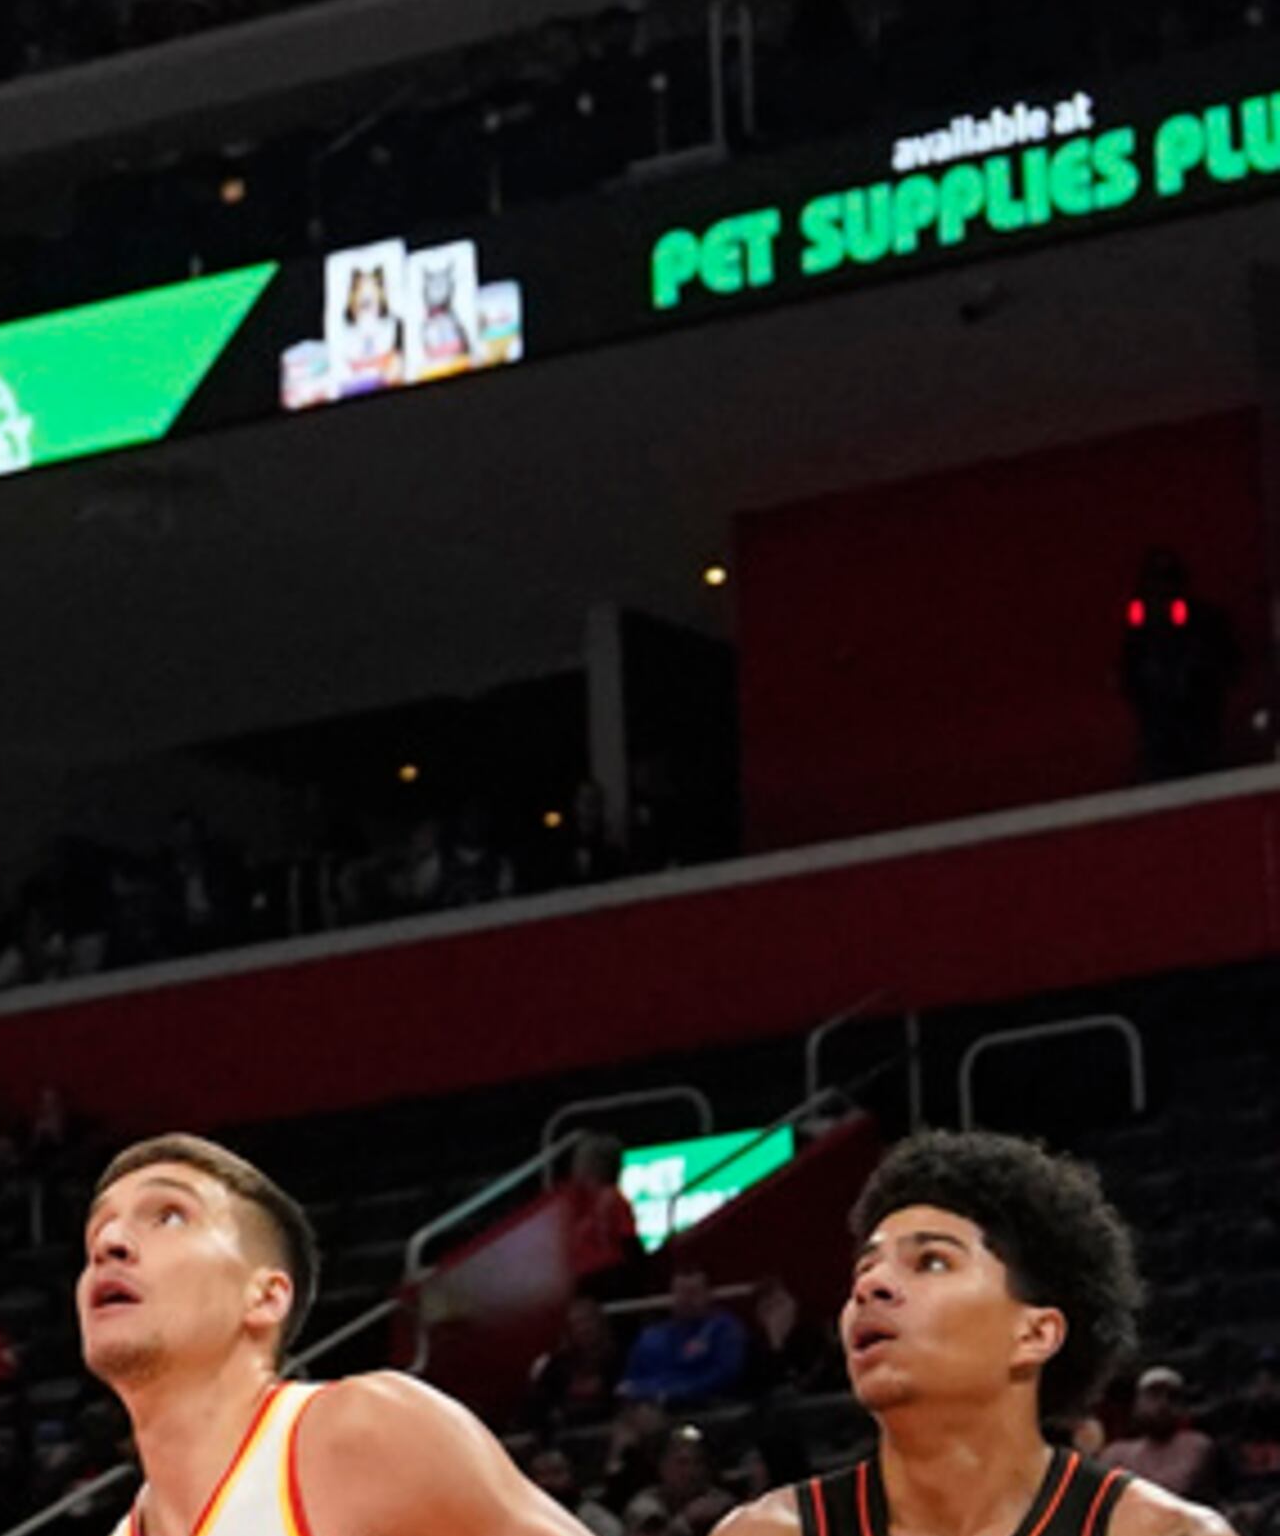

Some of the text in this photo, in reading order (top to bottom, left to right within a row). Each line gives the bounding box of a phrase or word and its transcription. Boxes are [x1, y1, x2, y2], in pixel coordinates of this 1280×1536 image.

[890, 91, 1095, 172] available at
[651, 208, 780, 310] PET
[800, 127, 1140, 275] SUPPLIES
